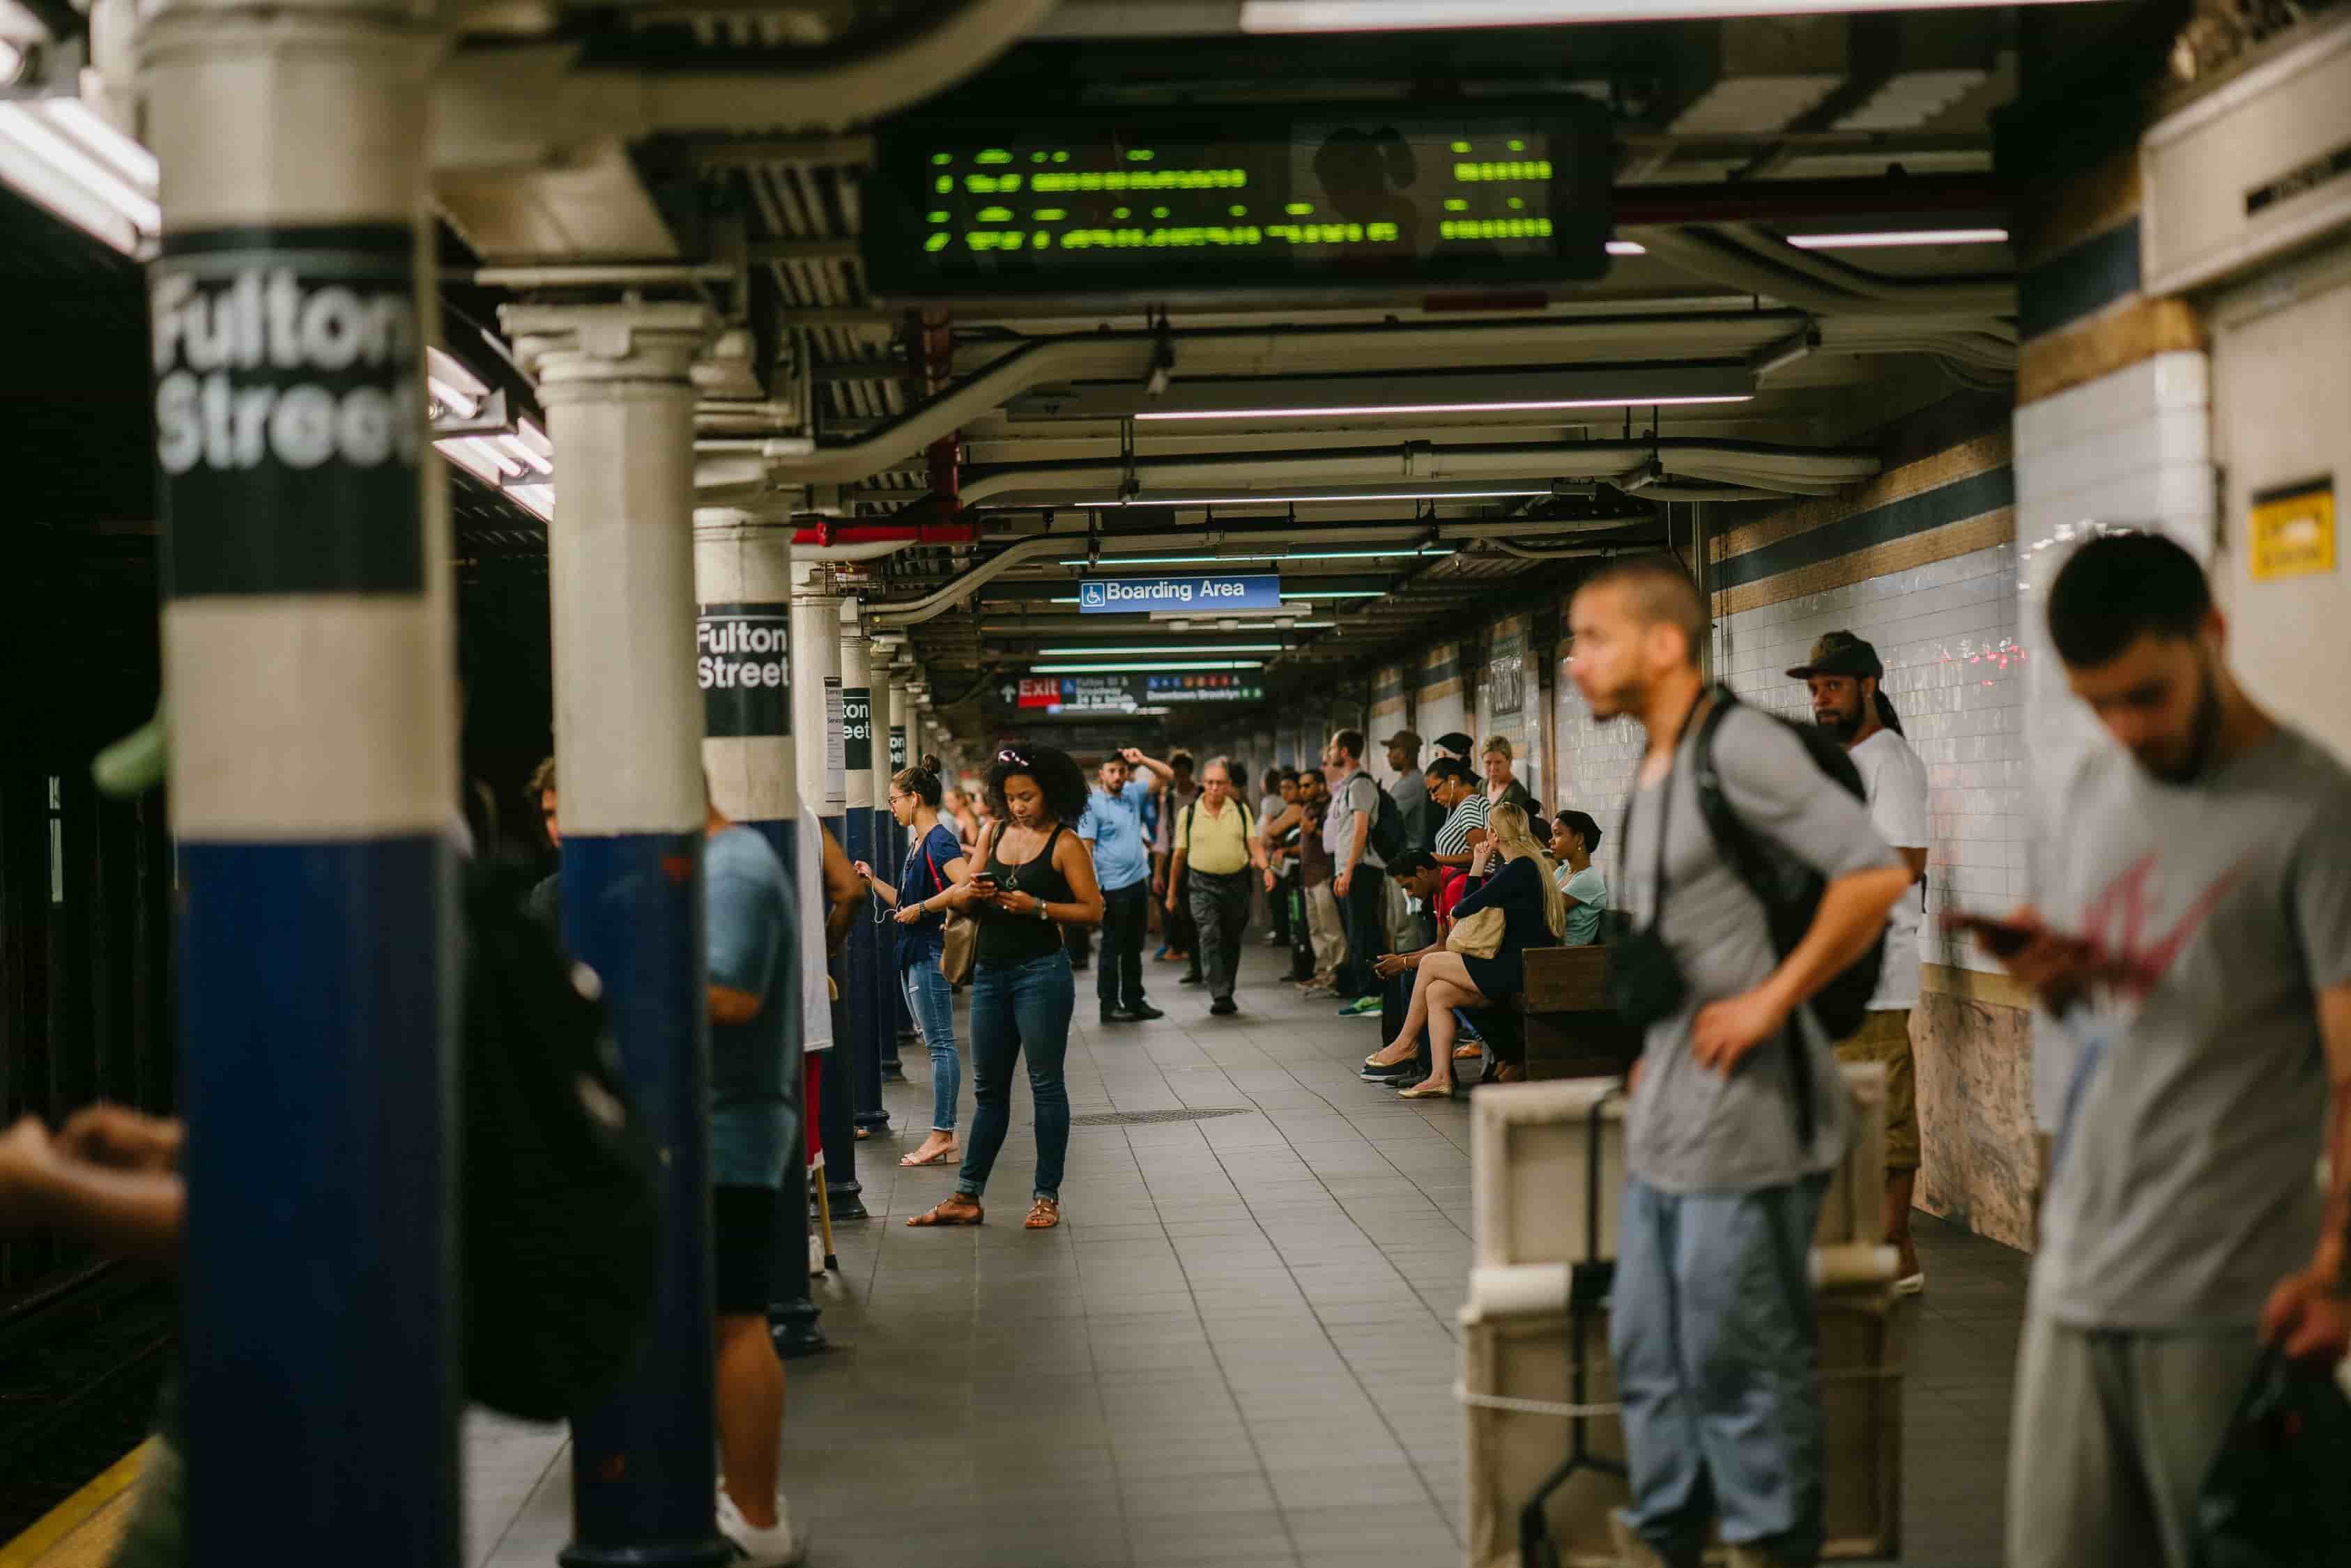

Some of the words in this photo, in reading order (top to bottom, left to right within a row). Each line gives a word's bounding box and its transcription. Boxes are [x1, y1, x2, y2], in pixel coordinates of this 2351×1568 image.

[151, 268, 415, 373] Fulton
[1106, 581, 1192, 601] Boarding
[1200, 581, 1244, 597] Area
[697, 622, 788, 654] Fulton
[698, 656, 790, 689] Street
[1019, 679, 1059, 696] Exit
[843, 700, 868, 718] ton
[843, 721, 870, 739] eet
